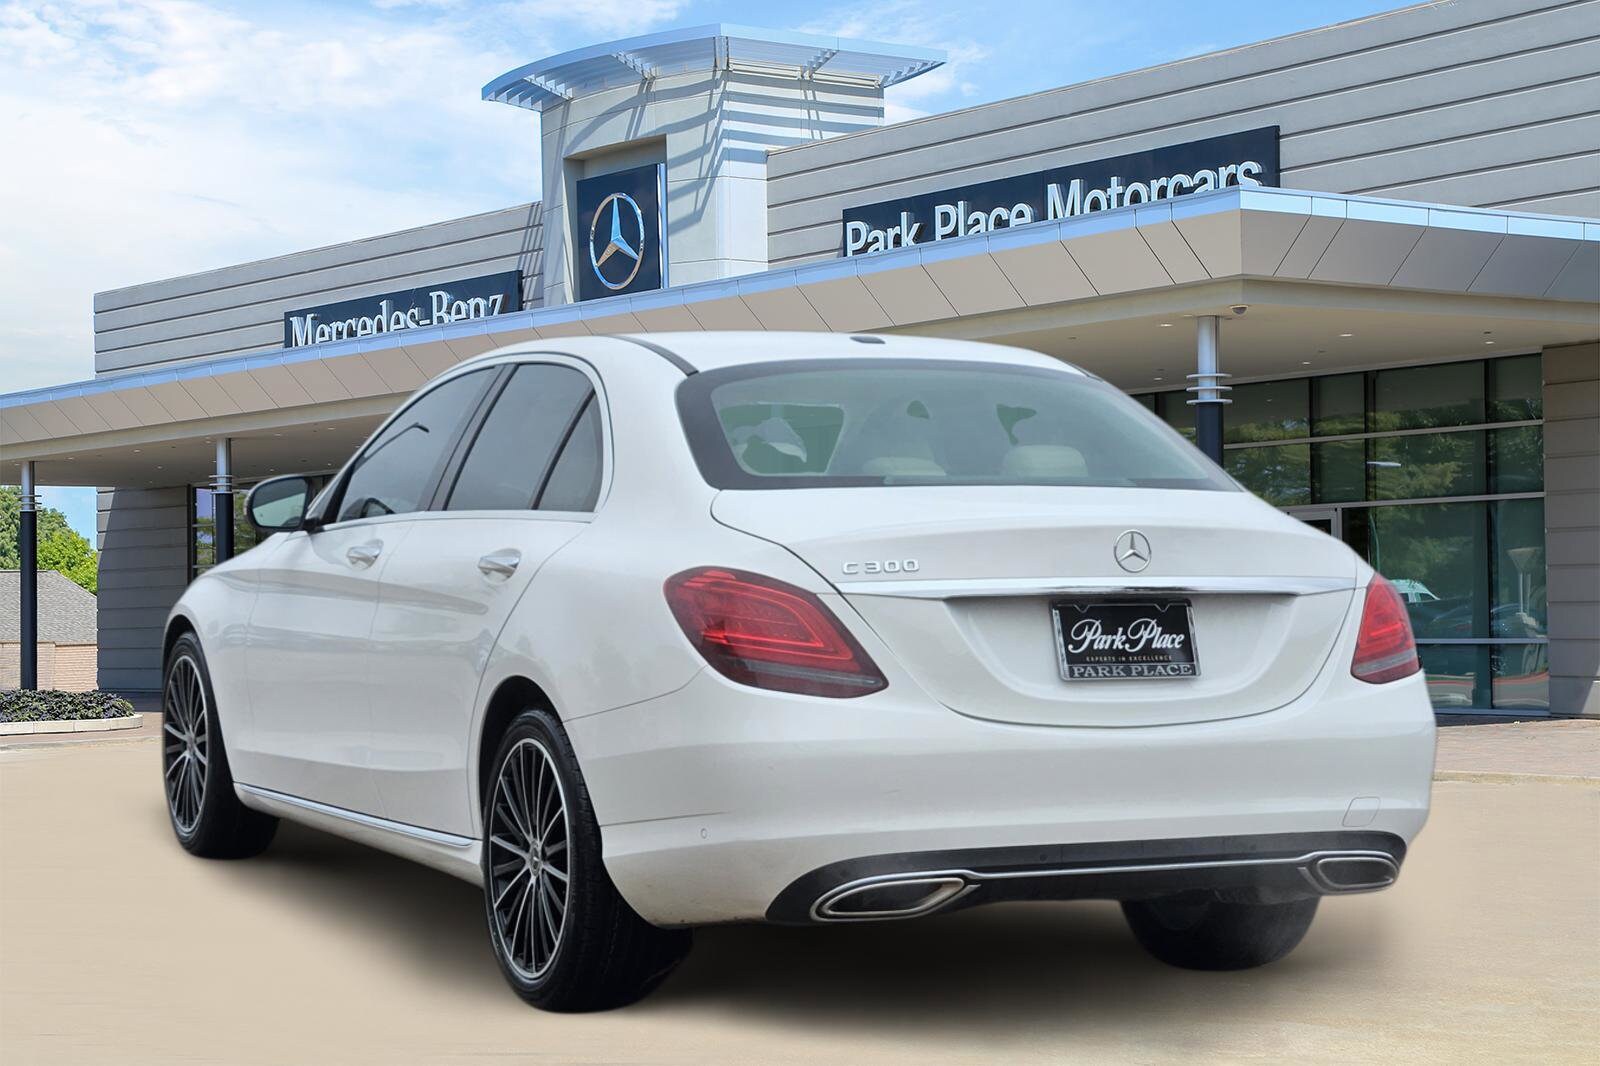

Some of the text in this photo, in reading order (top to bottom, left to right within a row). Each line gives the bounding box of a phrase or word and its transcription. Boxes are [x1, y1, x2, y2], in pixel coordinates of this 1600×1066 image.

[846, 160, 1263, 257] Park Place Motorcars
[290, 290, 504, 347] Mercedes-Benz
[842, 559, 920, 575] C 300
[1068, 618, 1185, 653] Park Place
[1071, 663, 1193, 678] PARK PLACE
[1128, 654, 1173, 662] EXCELLENCE
